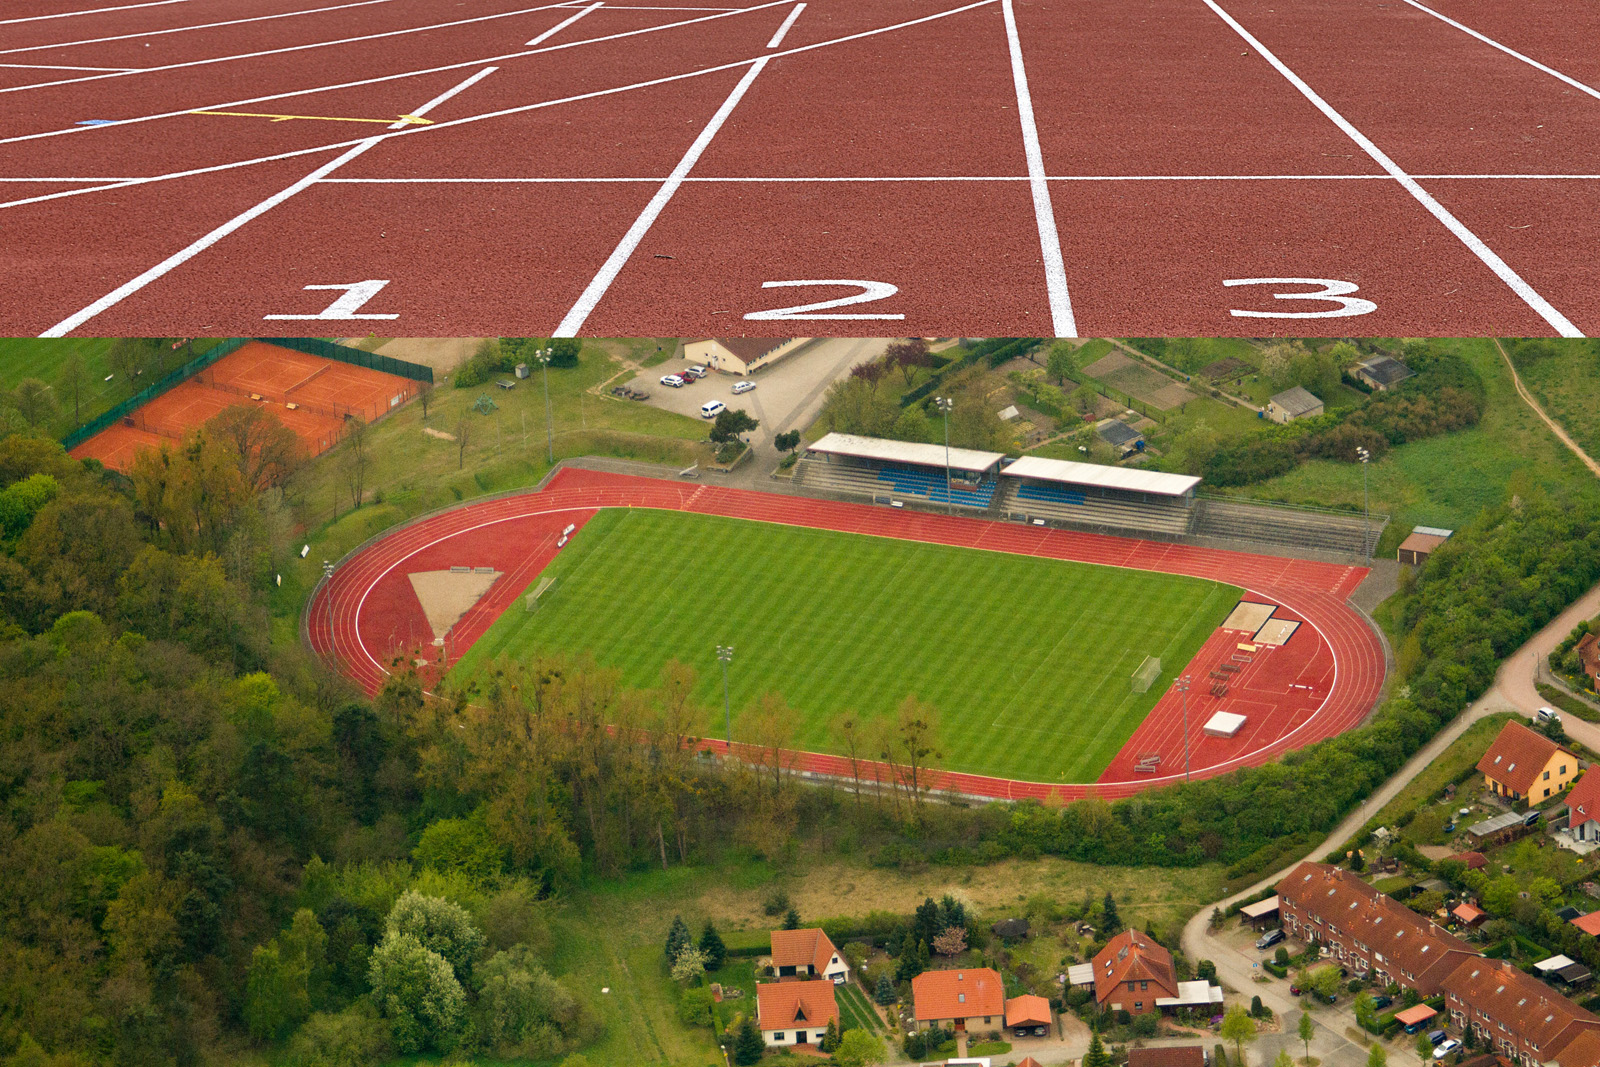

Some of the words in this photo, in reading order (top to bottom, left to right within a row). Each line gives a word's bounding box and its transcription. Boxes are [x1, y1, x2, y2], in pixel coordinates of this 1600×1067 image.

[264, 280, 399, 320] 1
[743, 280, 905, 320] 2
[1223, 278, 1377, 319] 3
